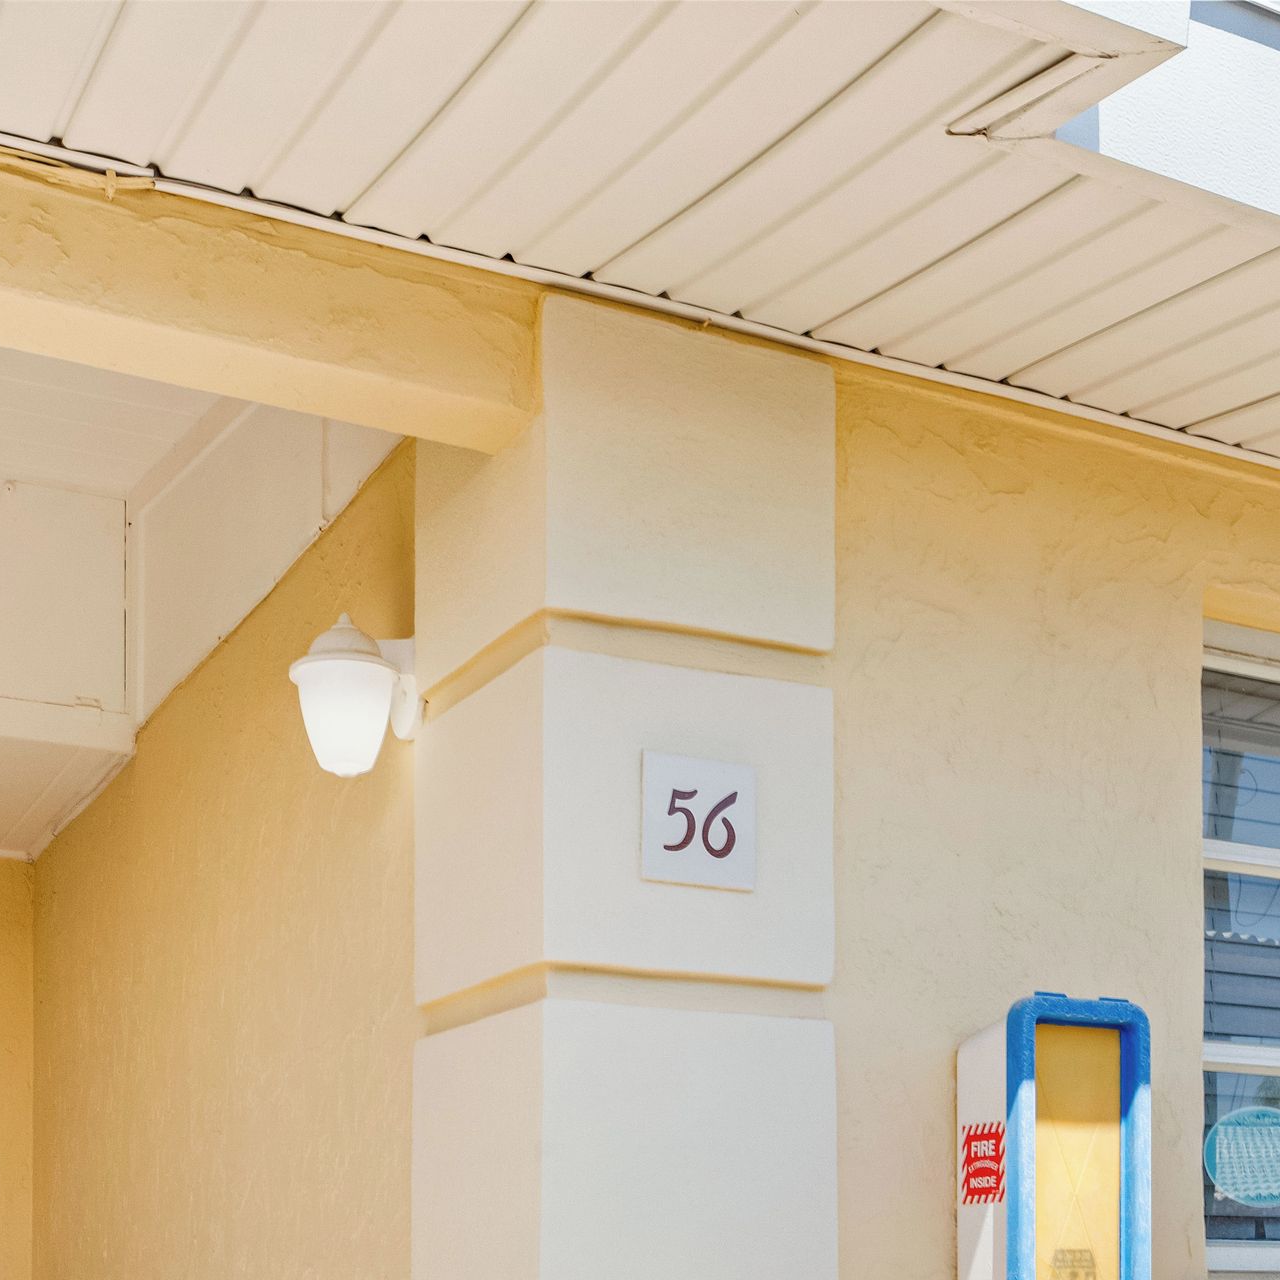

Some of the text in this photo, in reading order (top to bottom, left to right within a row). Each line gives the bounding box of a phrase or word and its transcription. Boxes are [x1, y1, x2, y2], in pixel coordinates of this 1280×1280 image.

[663, 788, 738, 859] 56
[971, 1139, 996, 1158] FIRE
[969, 1175, 997, 1189] INSIDE
